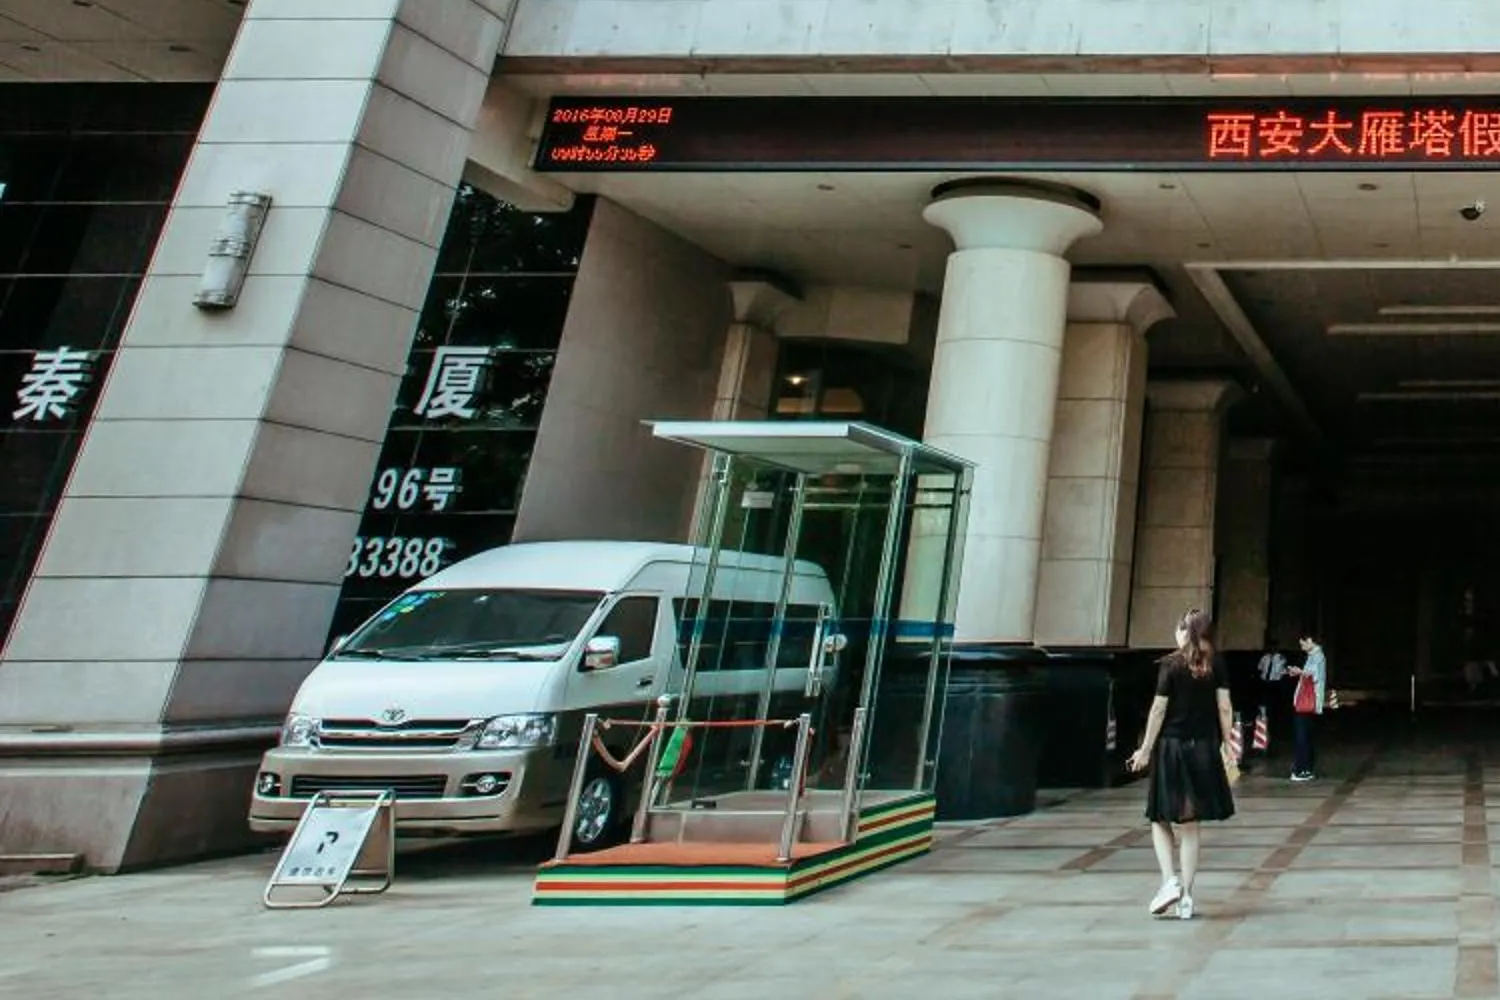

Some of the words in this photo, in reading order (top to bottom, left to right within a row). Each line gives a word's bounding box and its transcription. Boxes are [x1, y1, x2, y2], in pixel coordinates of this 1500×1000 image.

[12, 345, 90, 421] 秦
[413, 346, 490, 420] 厦
[373, 467, 456, 511] 96号
